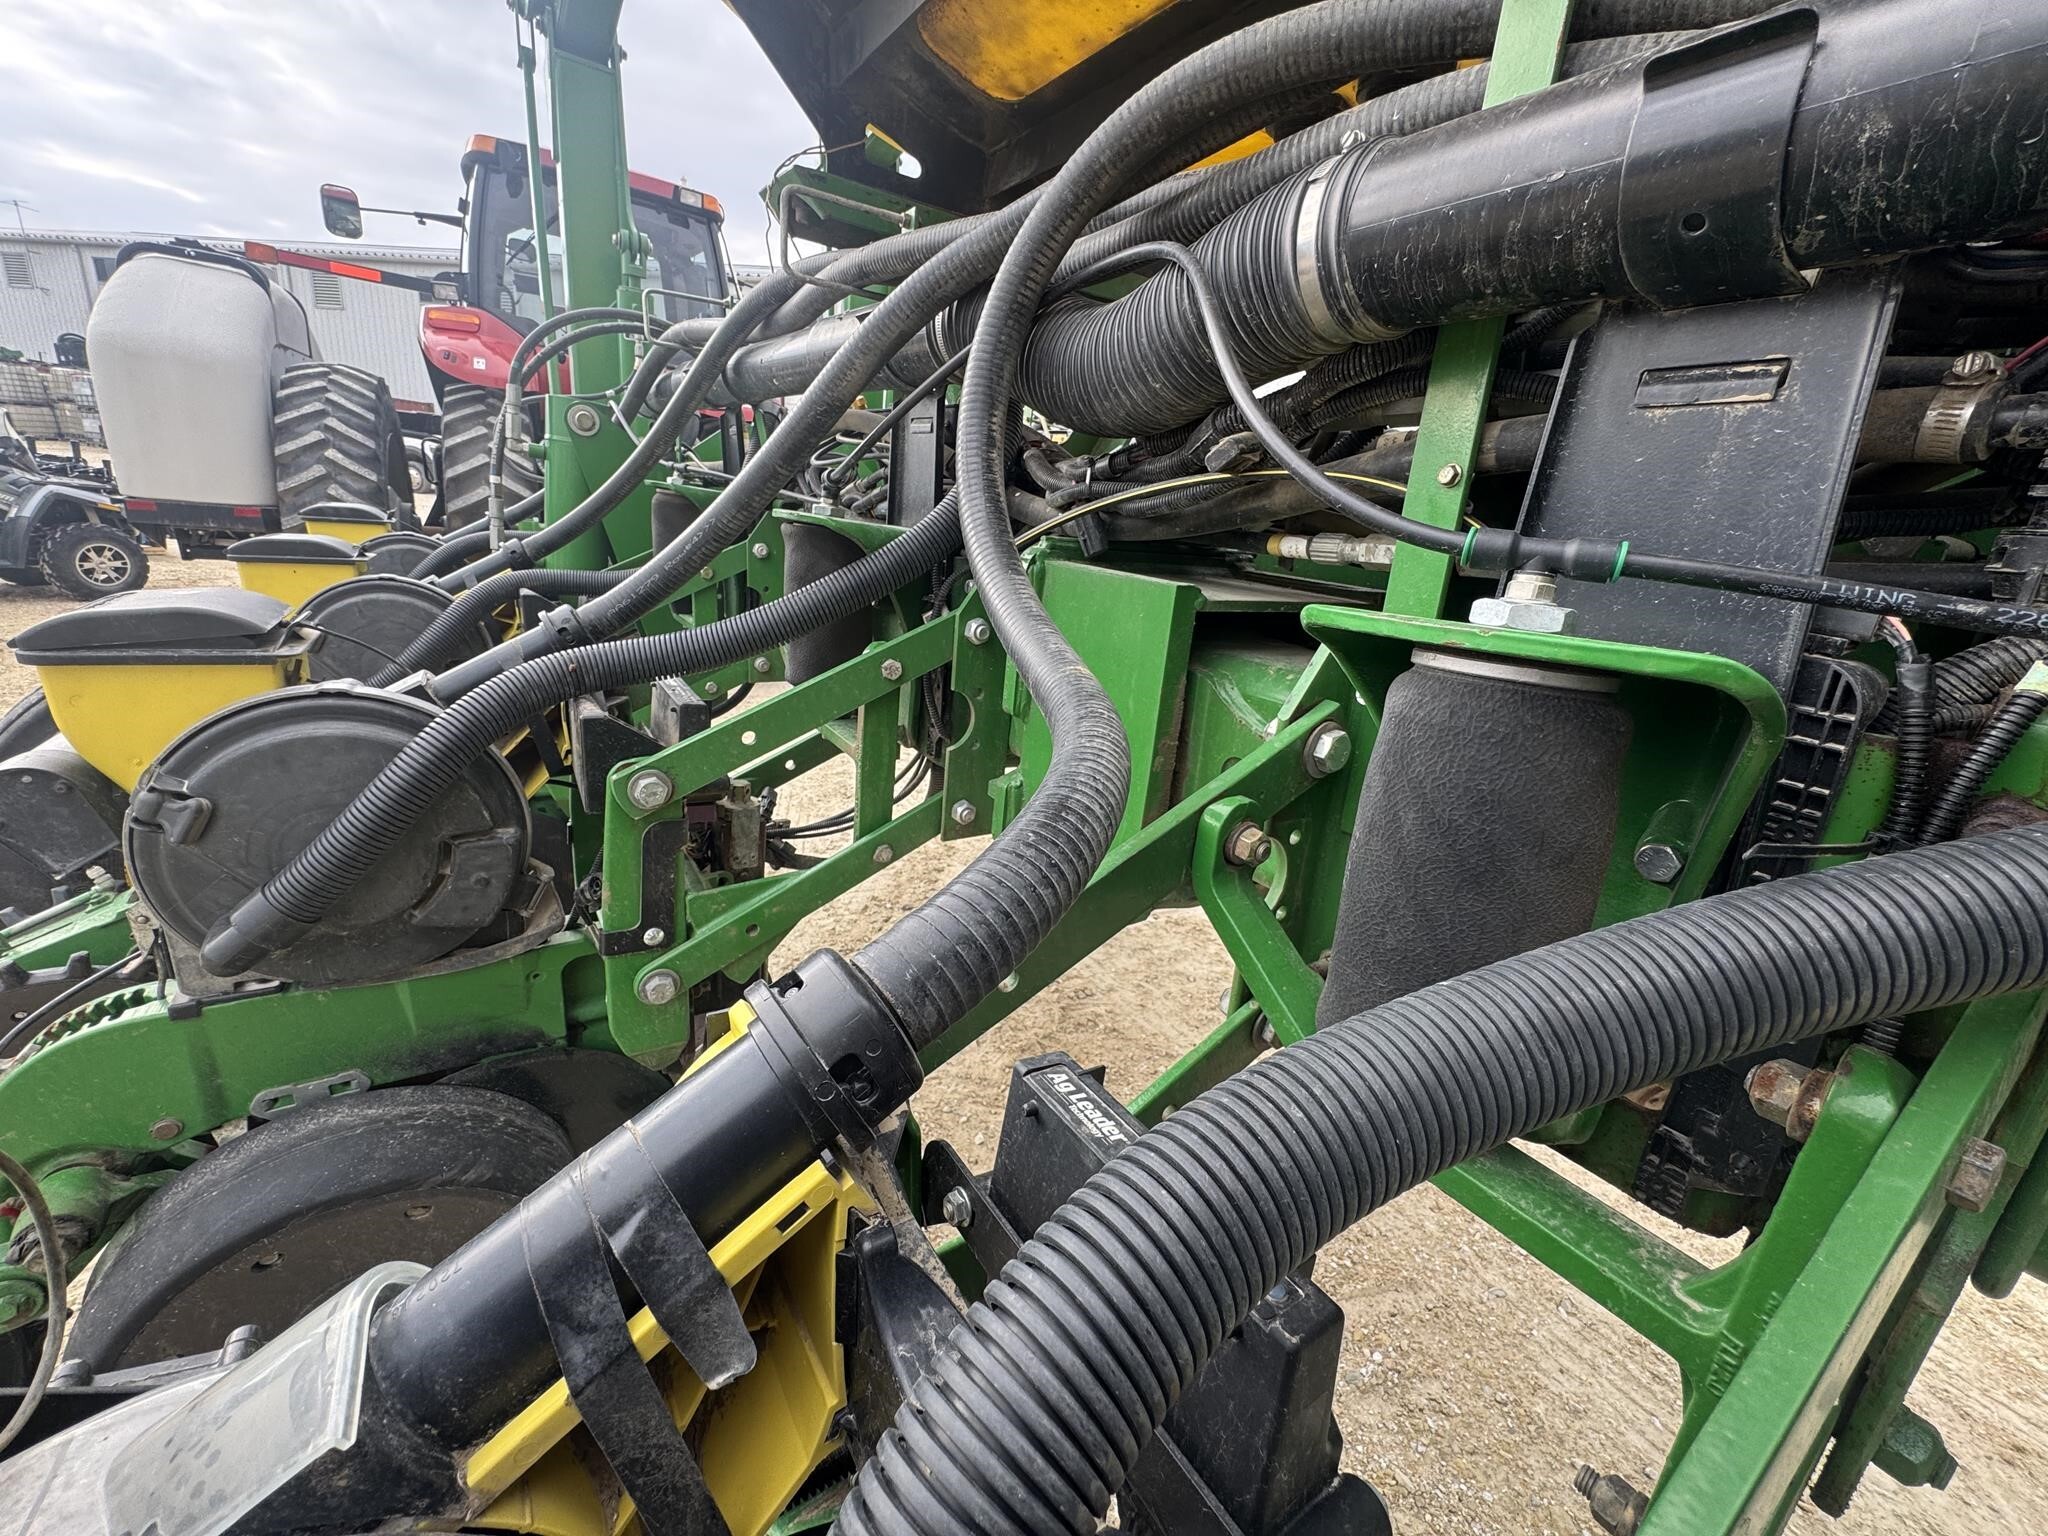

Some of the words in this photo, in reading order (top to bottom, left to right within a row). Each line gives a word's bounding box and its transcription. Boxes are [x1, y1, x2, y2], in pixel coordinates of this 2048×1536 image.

[1046, 1072, 1077, 1093] Ag
[1068, 1092, 1129, 1143] Leader
[1068, 1104, 1105, 1139] Technology
